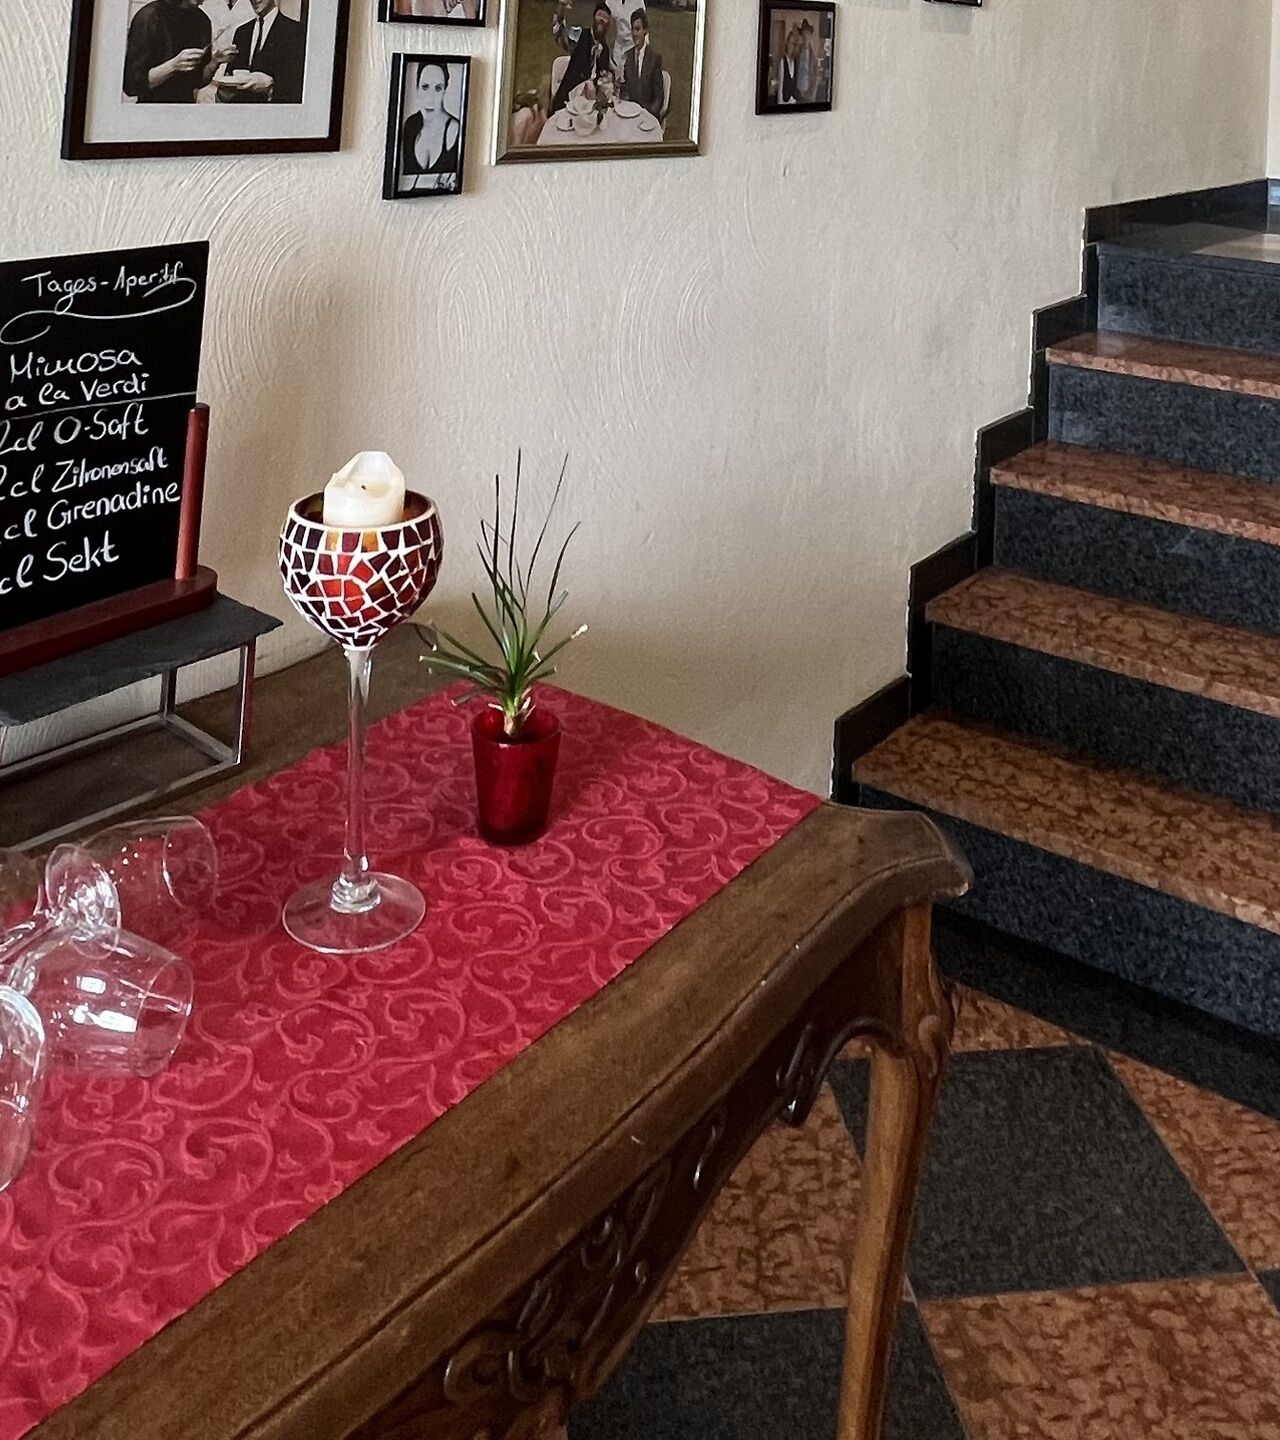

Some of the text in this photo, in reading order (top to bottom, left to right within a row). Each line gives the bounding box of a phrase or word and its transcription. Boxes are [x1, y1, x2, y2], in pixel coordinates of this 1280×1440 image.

[10, 350, 142, 383] Mimosa
[39, 383, 70, 405] la
[80, 373, 150, 401] Verdi
[47, 481, 180, 530] Grenadine
[43, 530, 119, 581] Sekt
